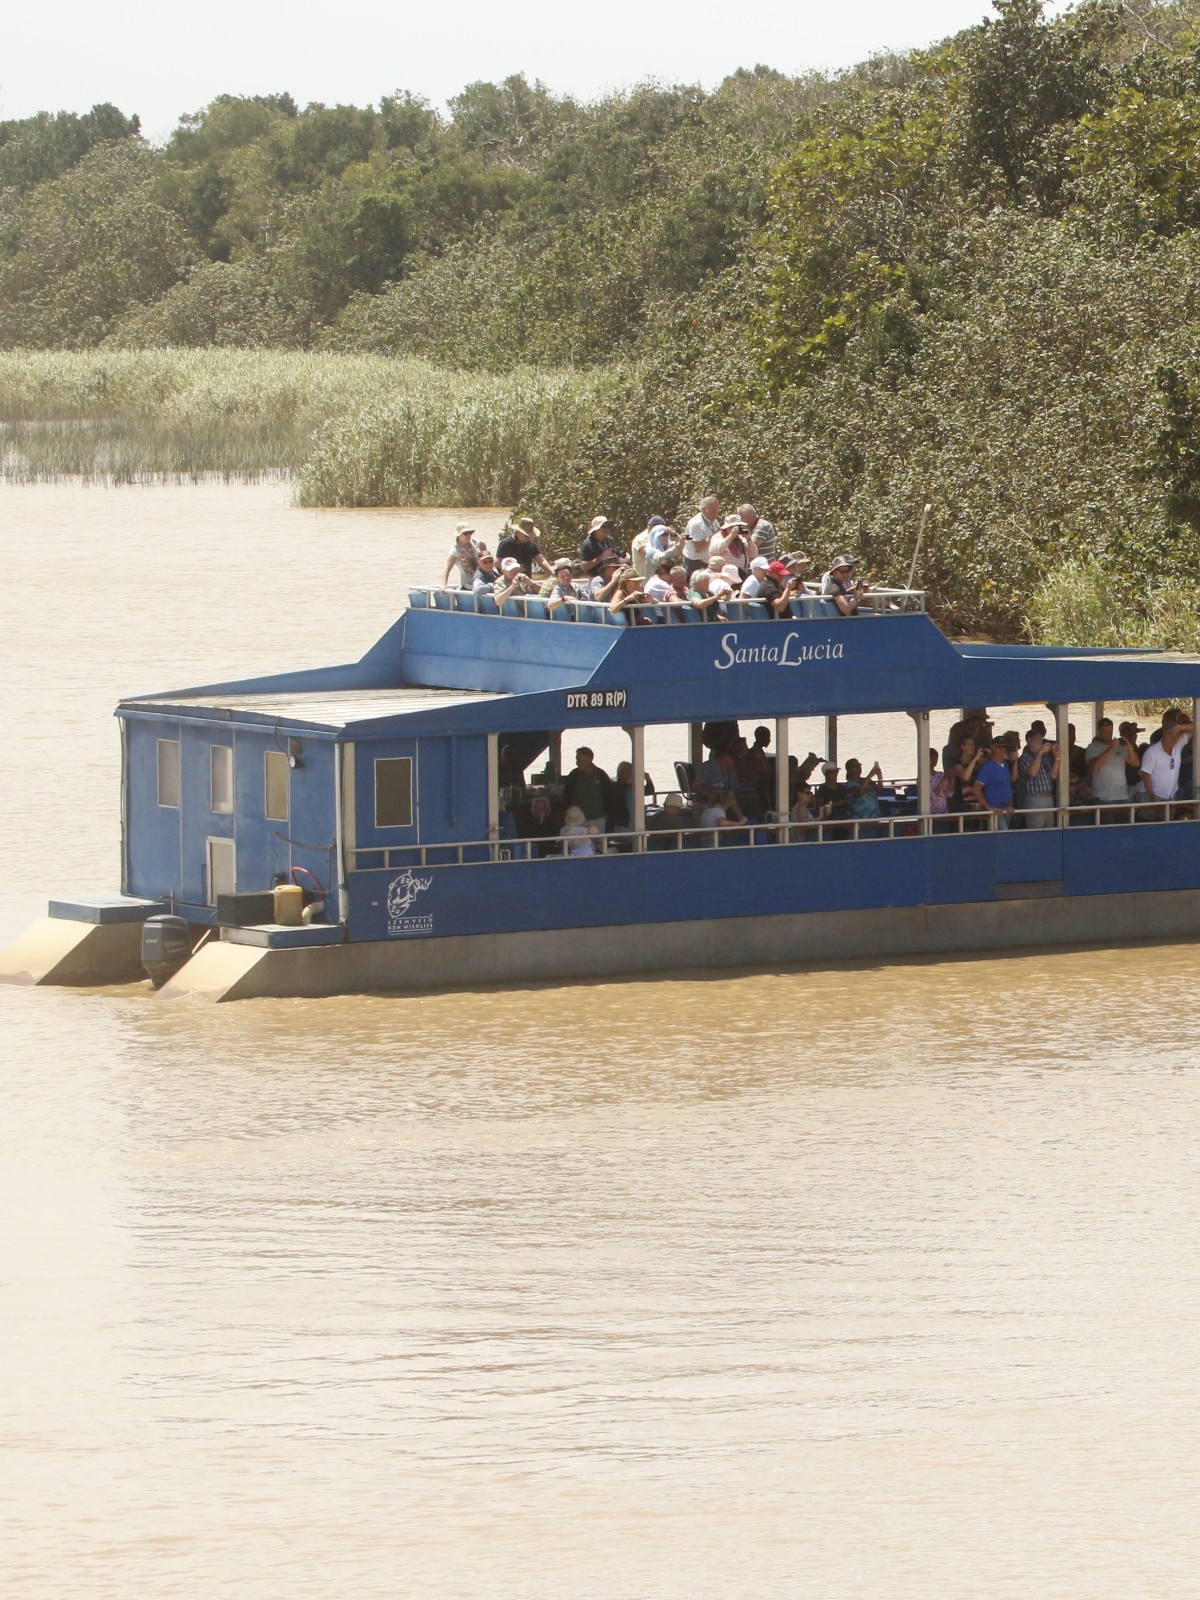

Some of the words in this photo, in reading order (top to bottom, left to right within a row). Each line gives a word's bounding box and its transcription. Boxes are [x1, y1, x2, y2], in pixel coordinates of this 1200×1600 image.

[566, 694, 588, 708] DTR
[590, 692, 604, 707] 89
[605, 690, 627, 708] R(P)
